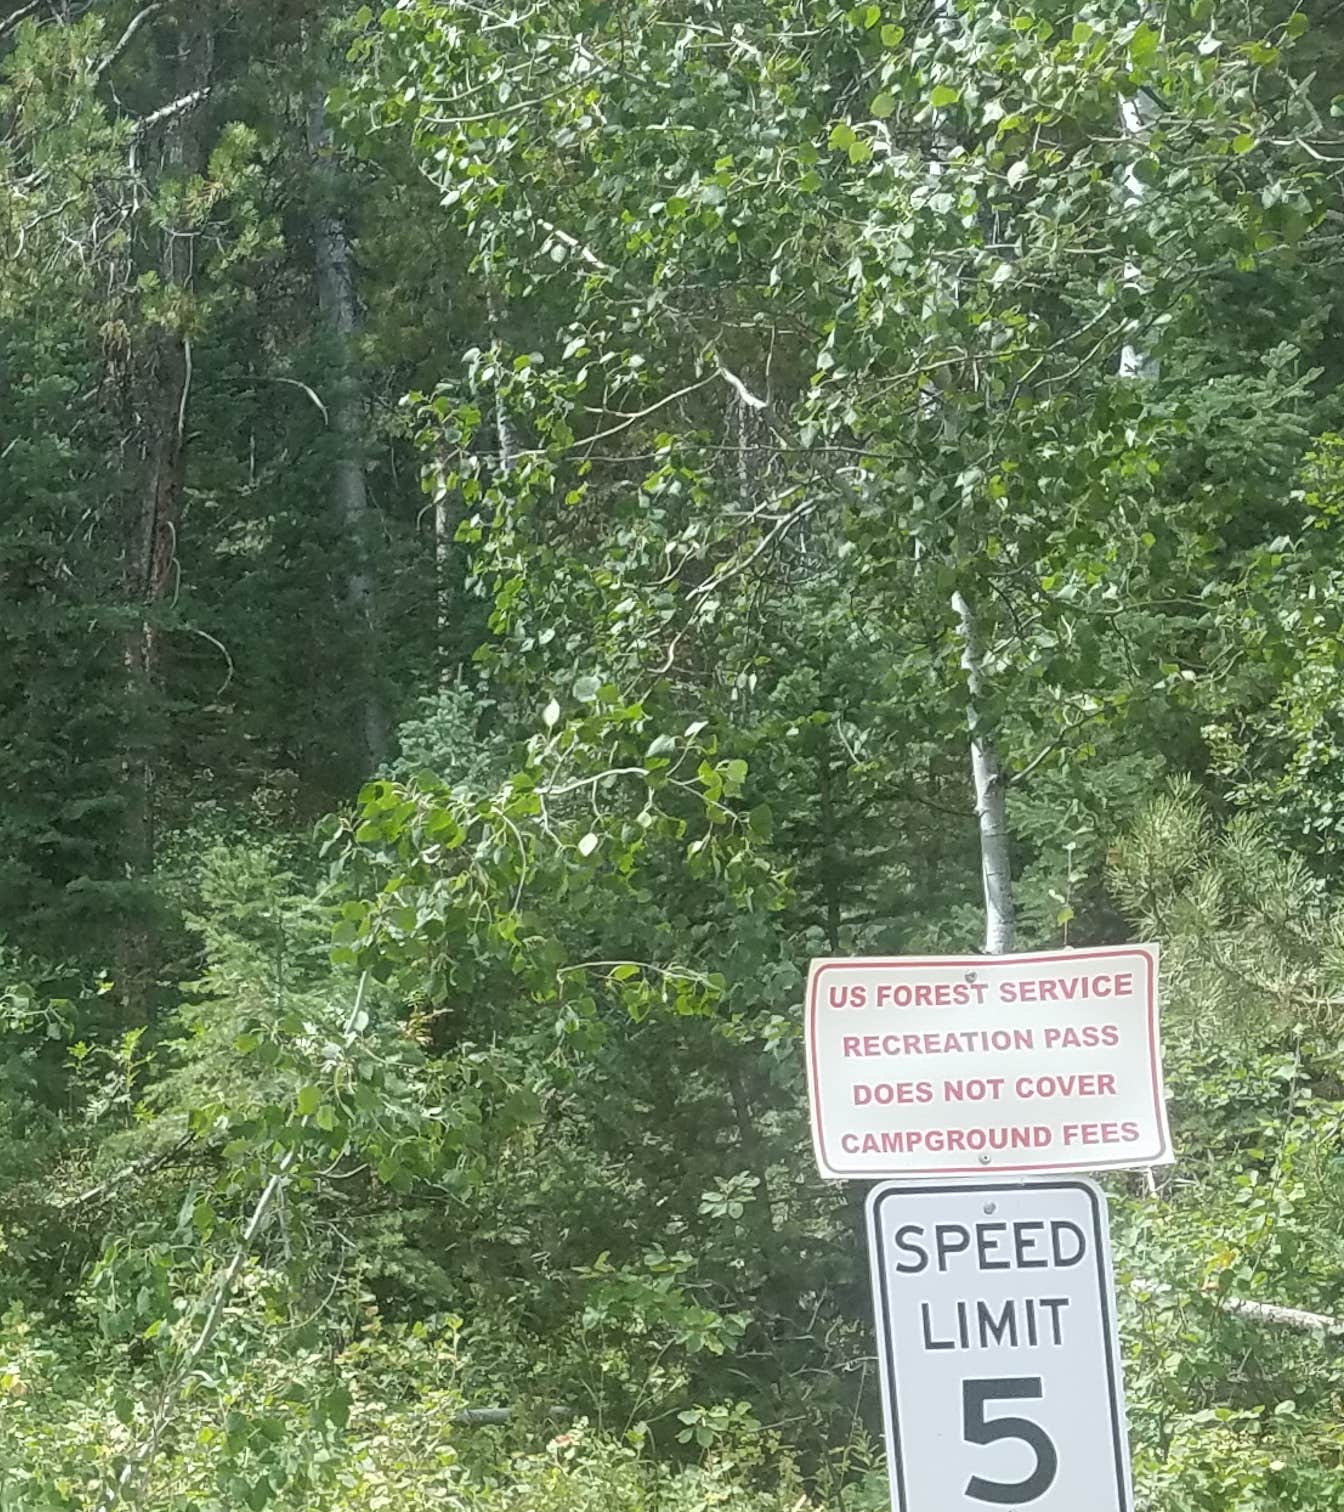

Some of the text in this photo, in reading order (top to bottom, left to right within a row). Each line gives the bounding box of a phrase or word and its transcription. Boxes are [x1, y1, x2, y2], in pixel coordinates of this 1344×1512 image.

[830, 973, 1133, 1008] US FOREST SERVICE
[843, 1025, 1119, 1057] RECREATION PASS
[853, 1074, 1116, 1105] DOES NOT COVER
[841, 1122, 1139, 1153] CAMPGROUND FEES
[895, 1221, 1086, 1273] SPEED
[922, 1298, 1069, 1350] LIMIT
[962, 1377, 1057, 1505] 5
